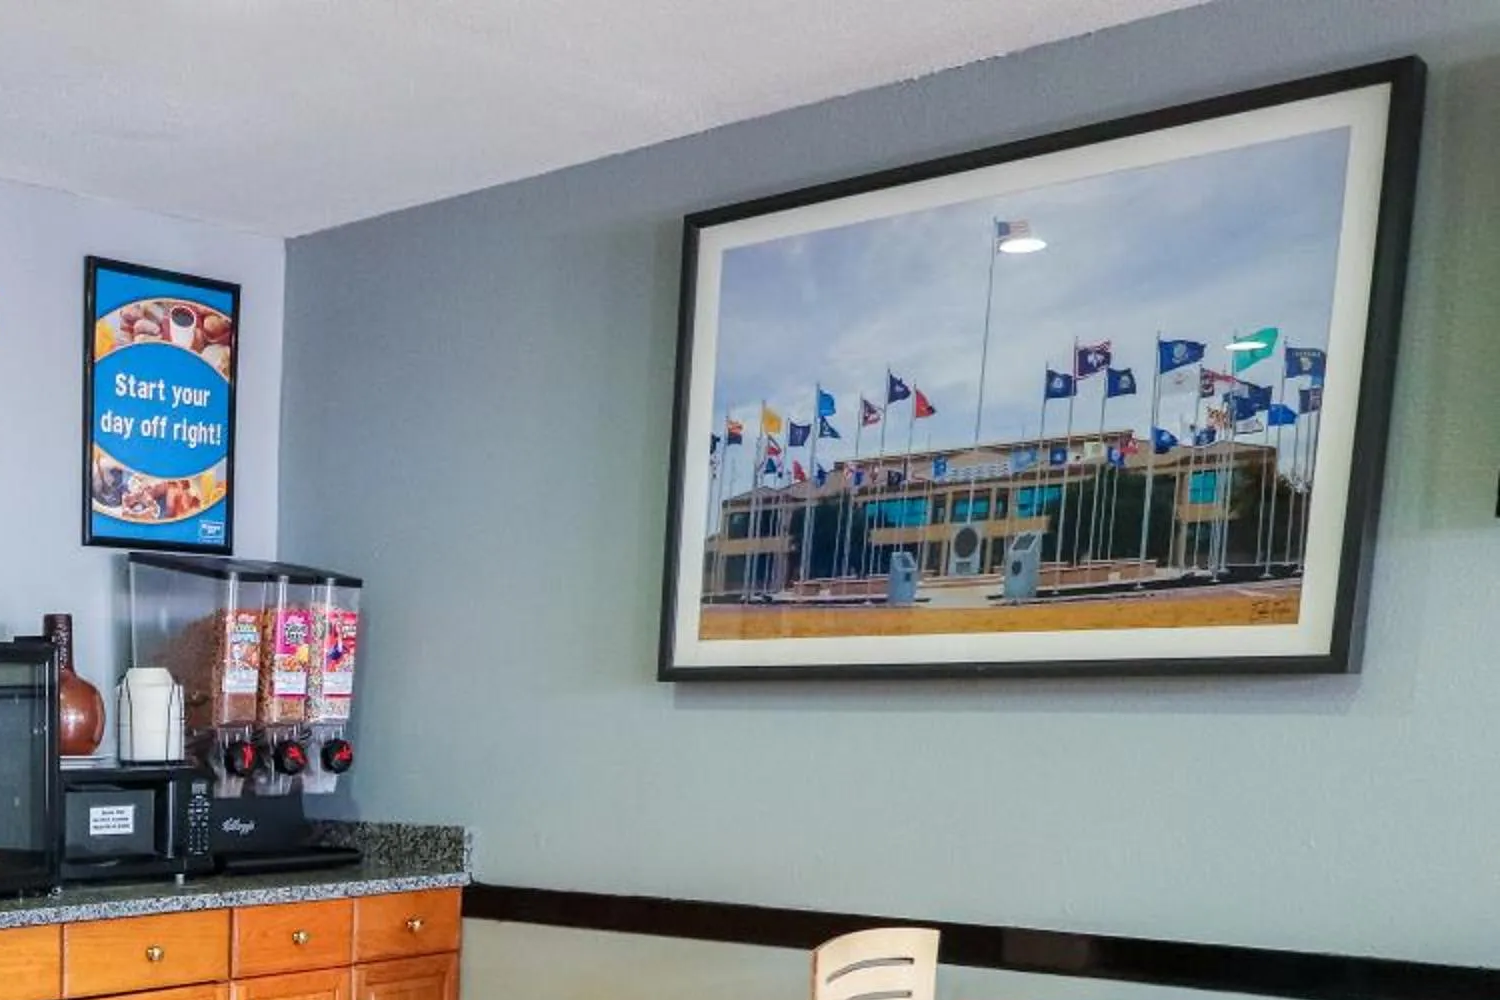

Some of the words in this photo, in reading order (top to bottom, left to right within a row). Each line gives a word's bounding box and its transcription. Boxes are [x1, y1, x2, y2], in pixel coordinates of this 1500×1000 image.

[115, 372, 166, 401] Start
[171, 385, 211, 408] your
[101, 409, 134, 440] day
[140, 416, 168, 439] off
[173, 418, 222, 449] right!
